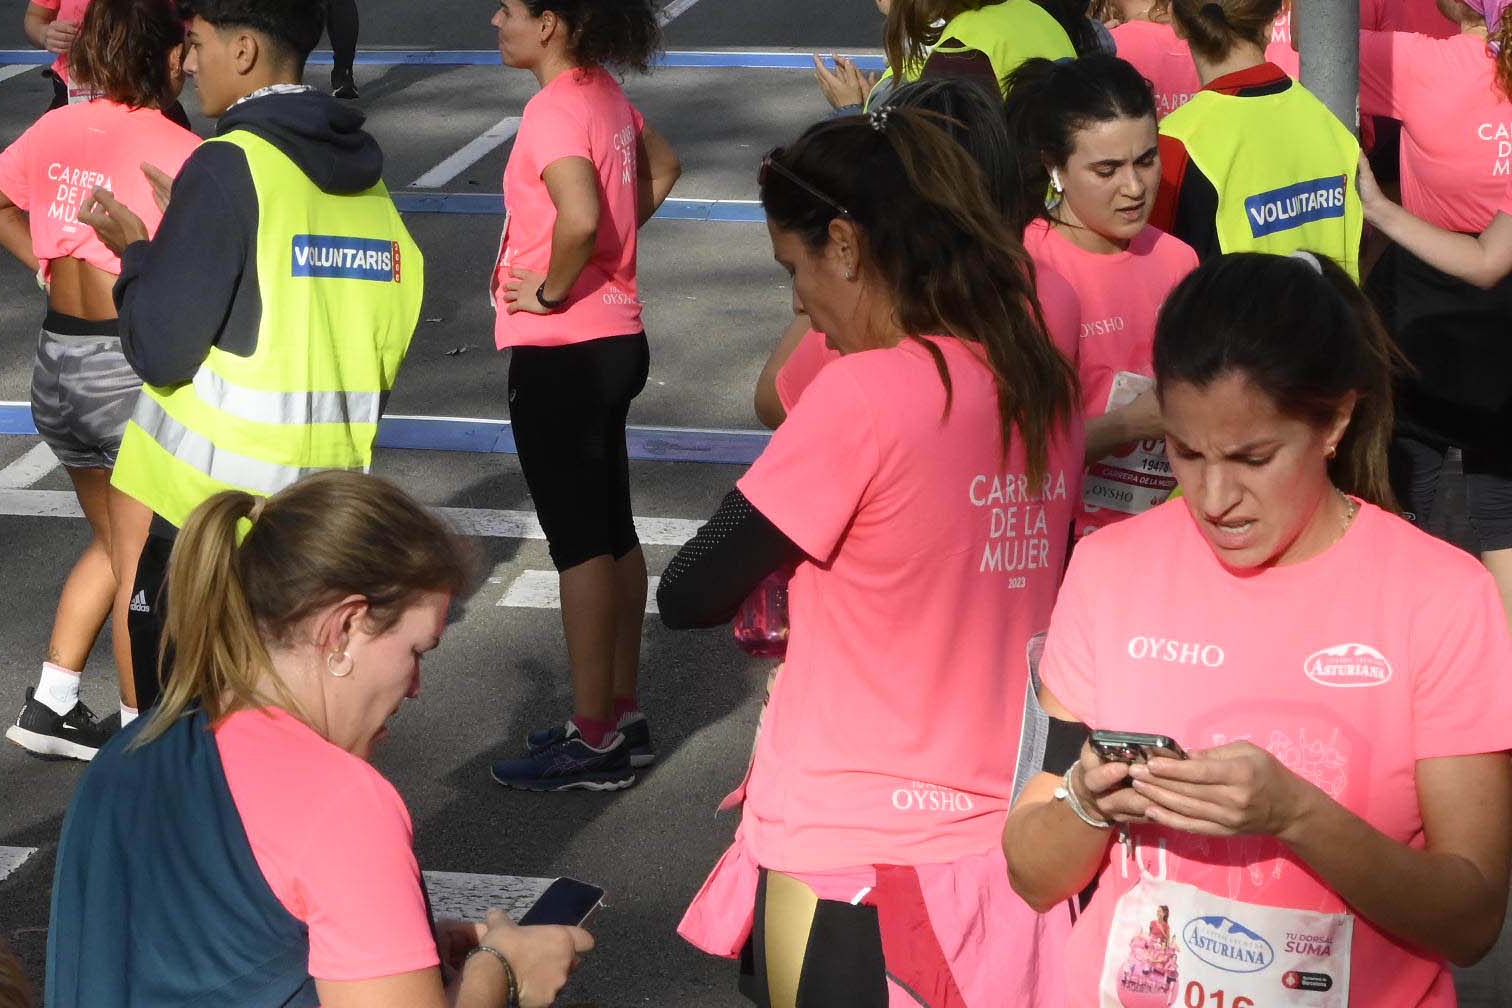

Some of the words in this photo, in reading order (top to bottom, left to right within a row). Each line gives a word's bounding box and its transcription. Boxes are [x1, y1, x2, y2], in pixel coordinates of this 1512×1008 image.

[1498, 141, 1512, 158] D
[48, 162, 113, 192] CARRERA
[56, 183, 78, 204] DE
[1250, 187, 1344, 226] VOLUNTARIS
[294, 246, 392, 271] VOLUNTARIS
[1091, 484, 1134, 502] OYSHO
[989, 506, 1017, 539] DE
[1024, 505, 1048, 536] LA
[979, 538, 1049, 573] MUJER
[1126, 635, 1226, 669] OYSHO
[1311, 658, 1386, 680] ASTURIANA
[891, 788, 973, 812] OYSHO
[1189, 926, 1265, 966] ASTURIANA
[1284, 940, 1332, 957] SUMA
